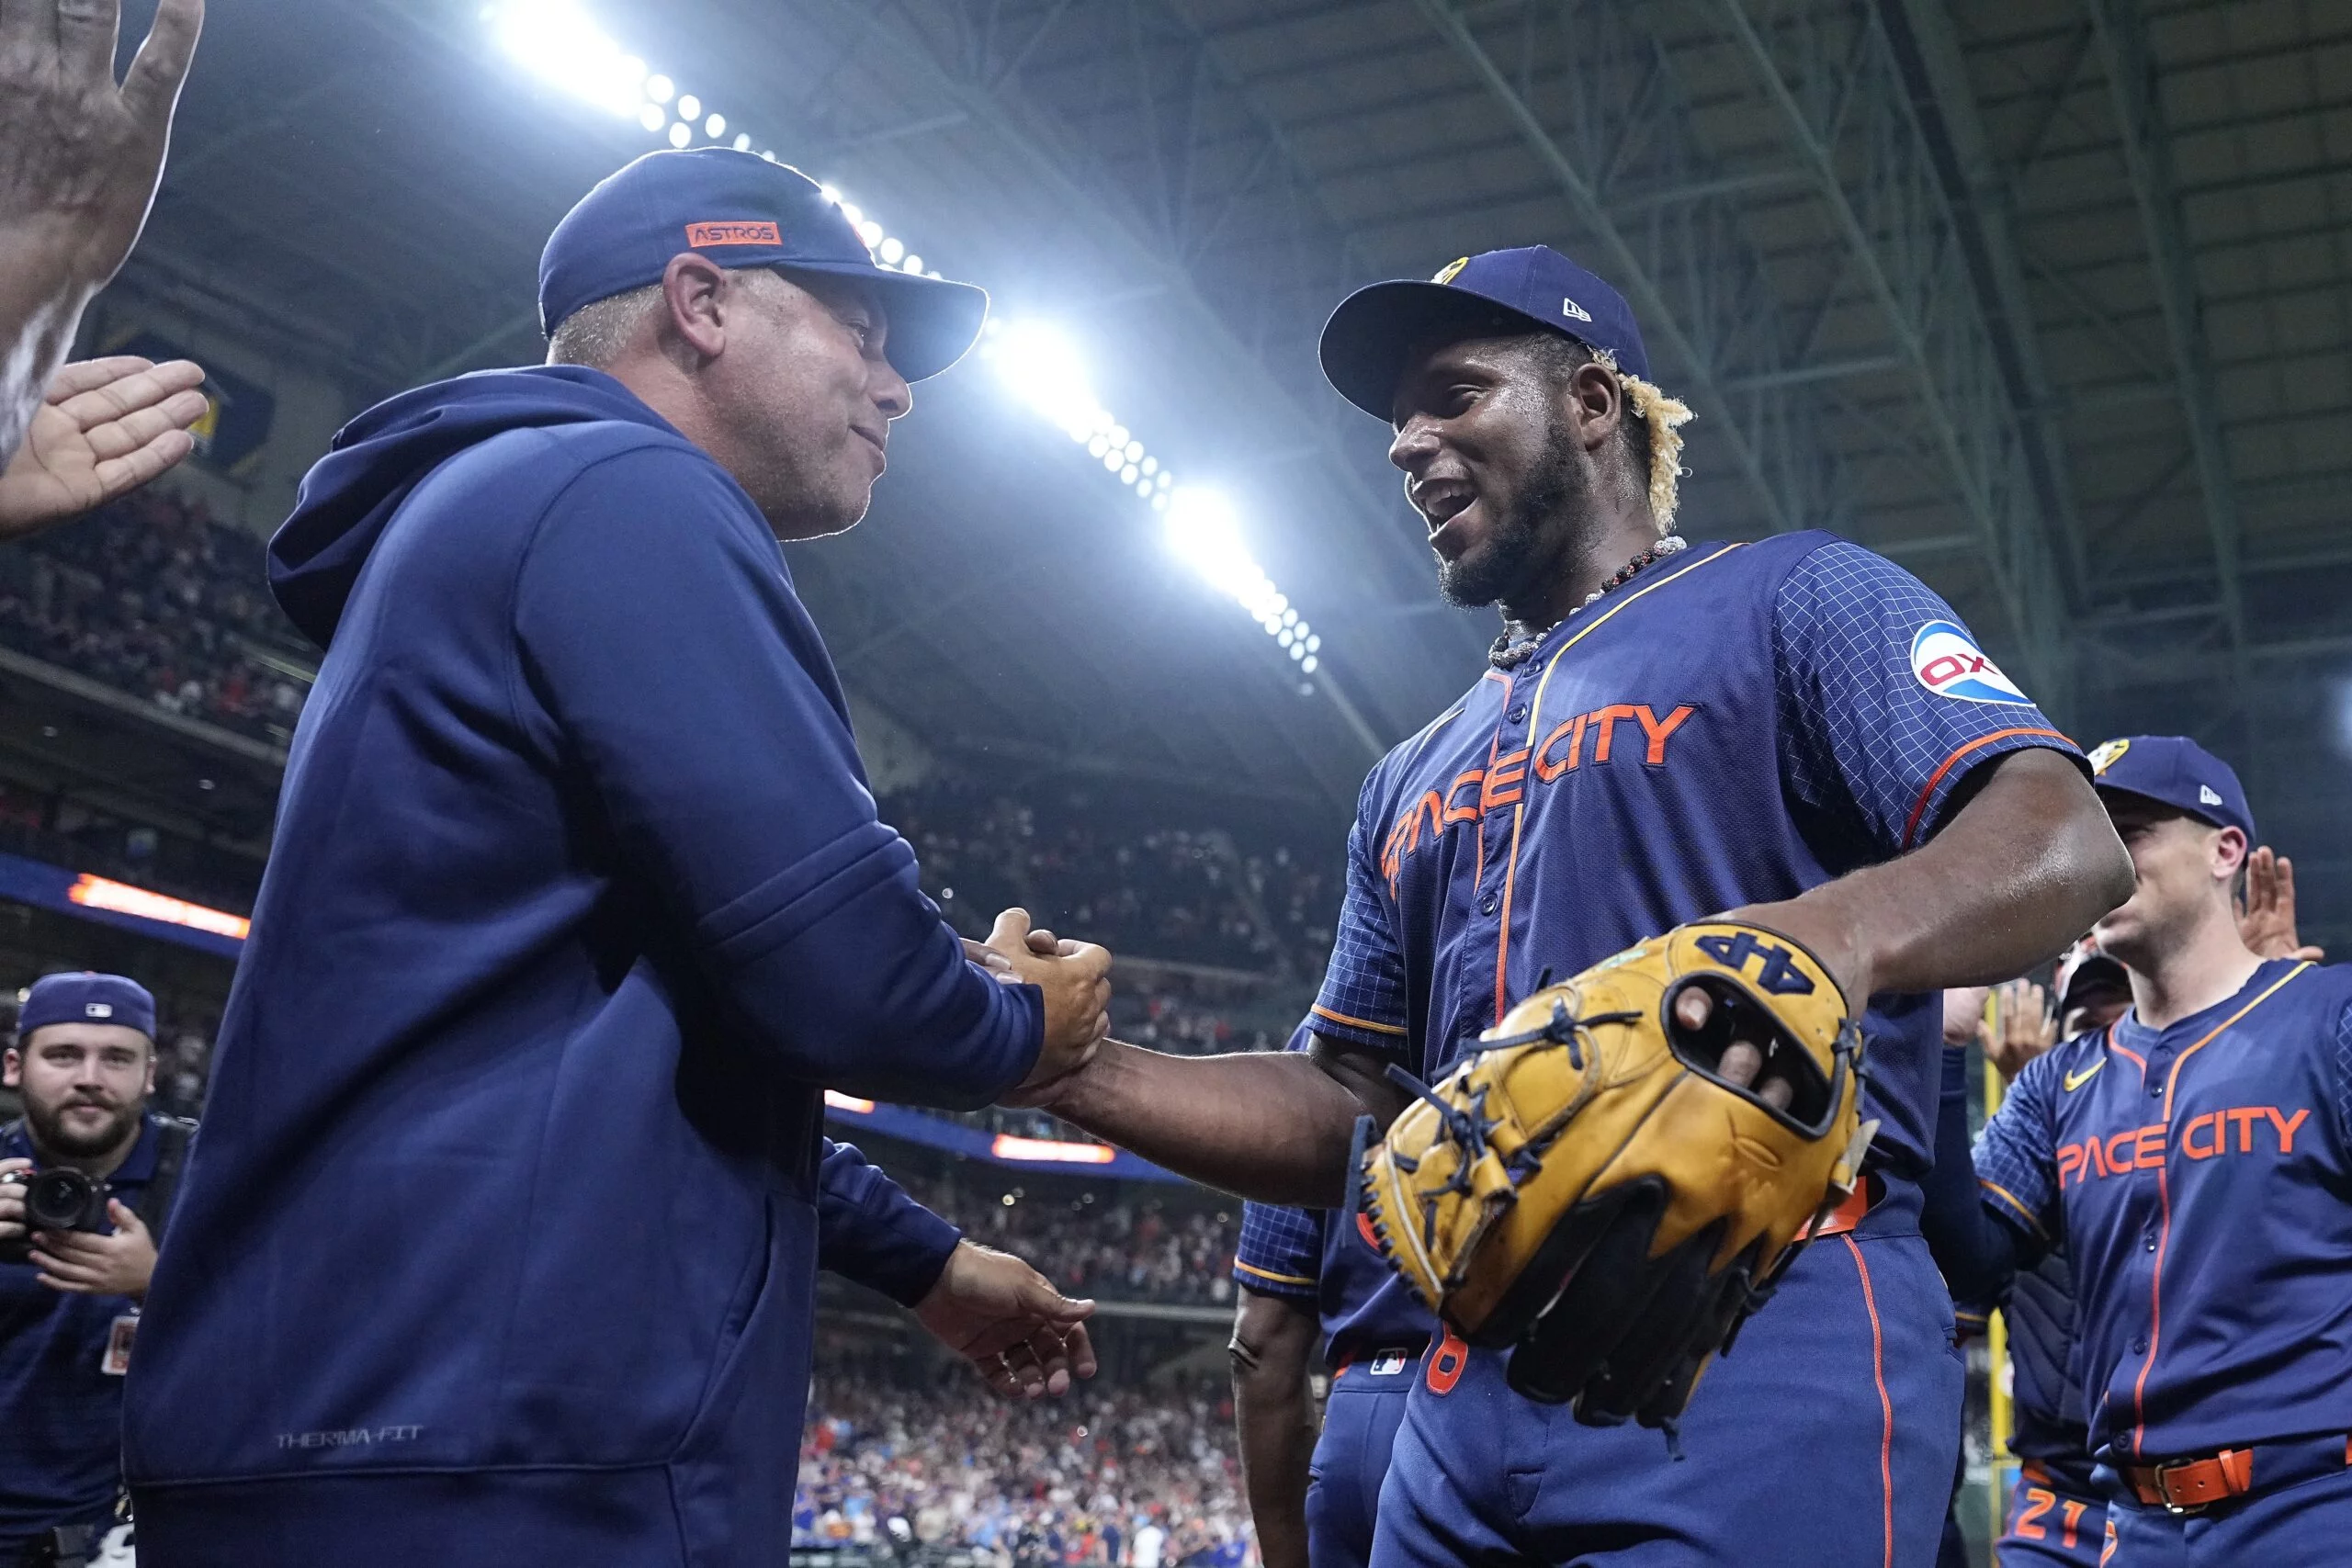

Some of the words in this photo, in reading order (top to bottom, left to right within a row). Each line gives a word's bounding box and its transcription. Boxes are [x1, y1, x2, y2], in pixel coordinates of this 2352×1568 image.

[695, 226, 775, 243] ASTROS
[1920, 653, 2000, 686] OX
[1380, 748, 1532, 903] PACE
[1534, 703, 1697, 784] CITY
[2056, 1122, 2167, 1190] PACE
[2181, 1105, 2312, 1161] CITY
[2014, 1487, 2088, 1549] 21
